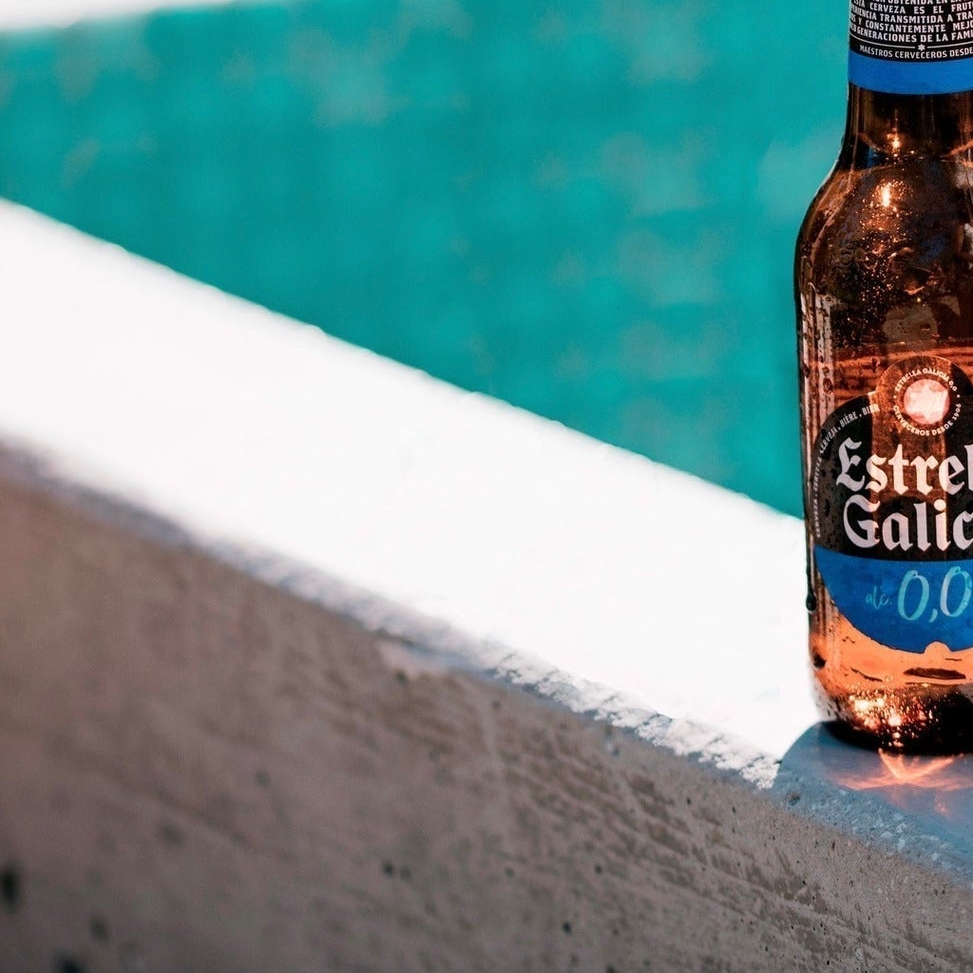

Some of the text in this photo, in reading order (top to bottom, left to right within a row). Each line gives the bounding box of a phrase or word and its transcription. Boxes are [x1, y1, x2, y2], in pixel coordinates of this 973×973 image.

[870, 2, 906, 14] CERVEZA
[914, 6, 925, 14] ES
[933, 6, 944, 14] EL
[858, 17, 862, 25] Y
[866, 20, 946, 33] CONSTANTEMENTE
[880, 13, 943, 24] TRANSMITIDA
[947, 14, 953, 22] A
[857, 27, 917, 42] GENERACIONES
[920, 34, 933, 42] DE
[936, 34, 948, 42] LA
[860, 45, 893, 58] MAESTROS
[895, 50, 947, 59] CERVECEROS
[949, 47, 973, 57] DESDE
[895, 369, 922, 391] ESTRELLA
[922, 368, 949, 382] GALICIA
[893, 403, 961, 436] CERVECEROS DESDE 1906
[898, 566, 973, 623] 0,0
